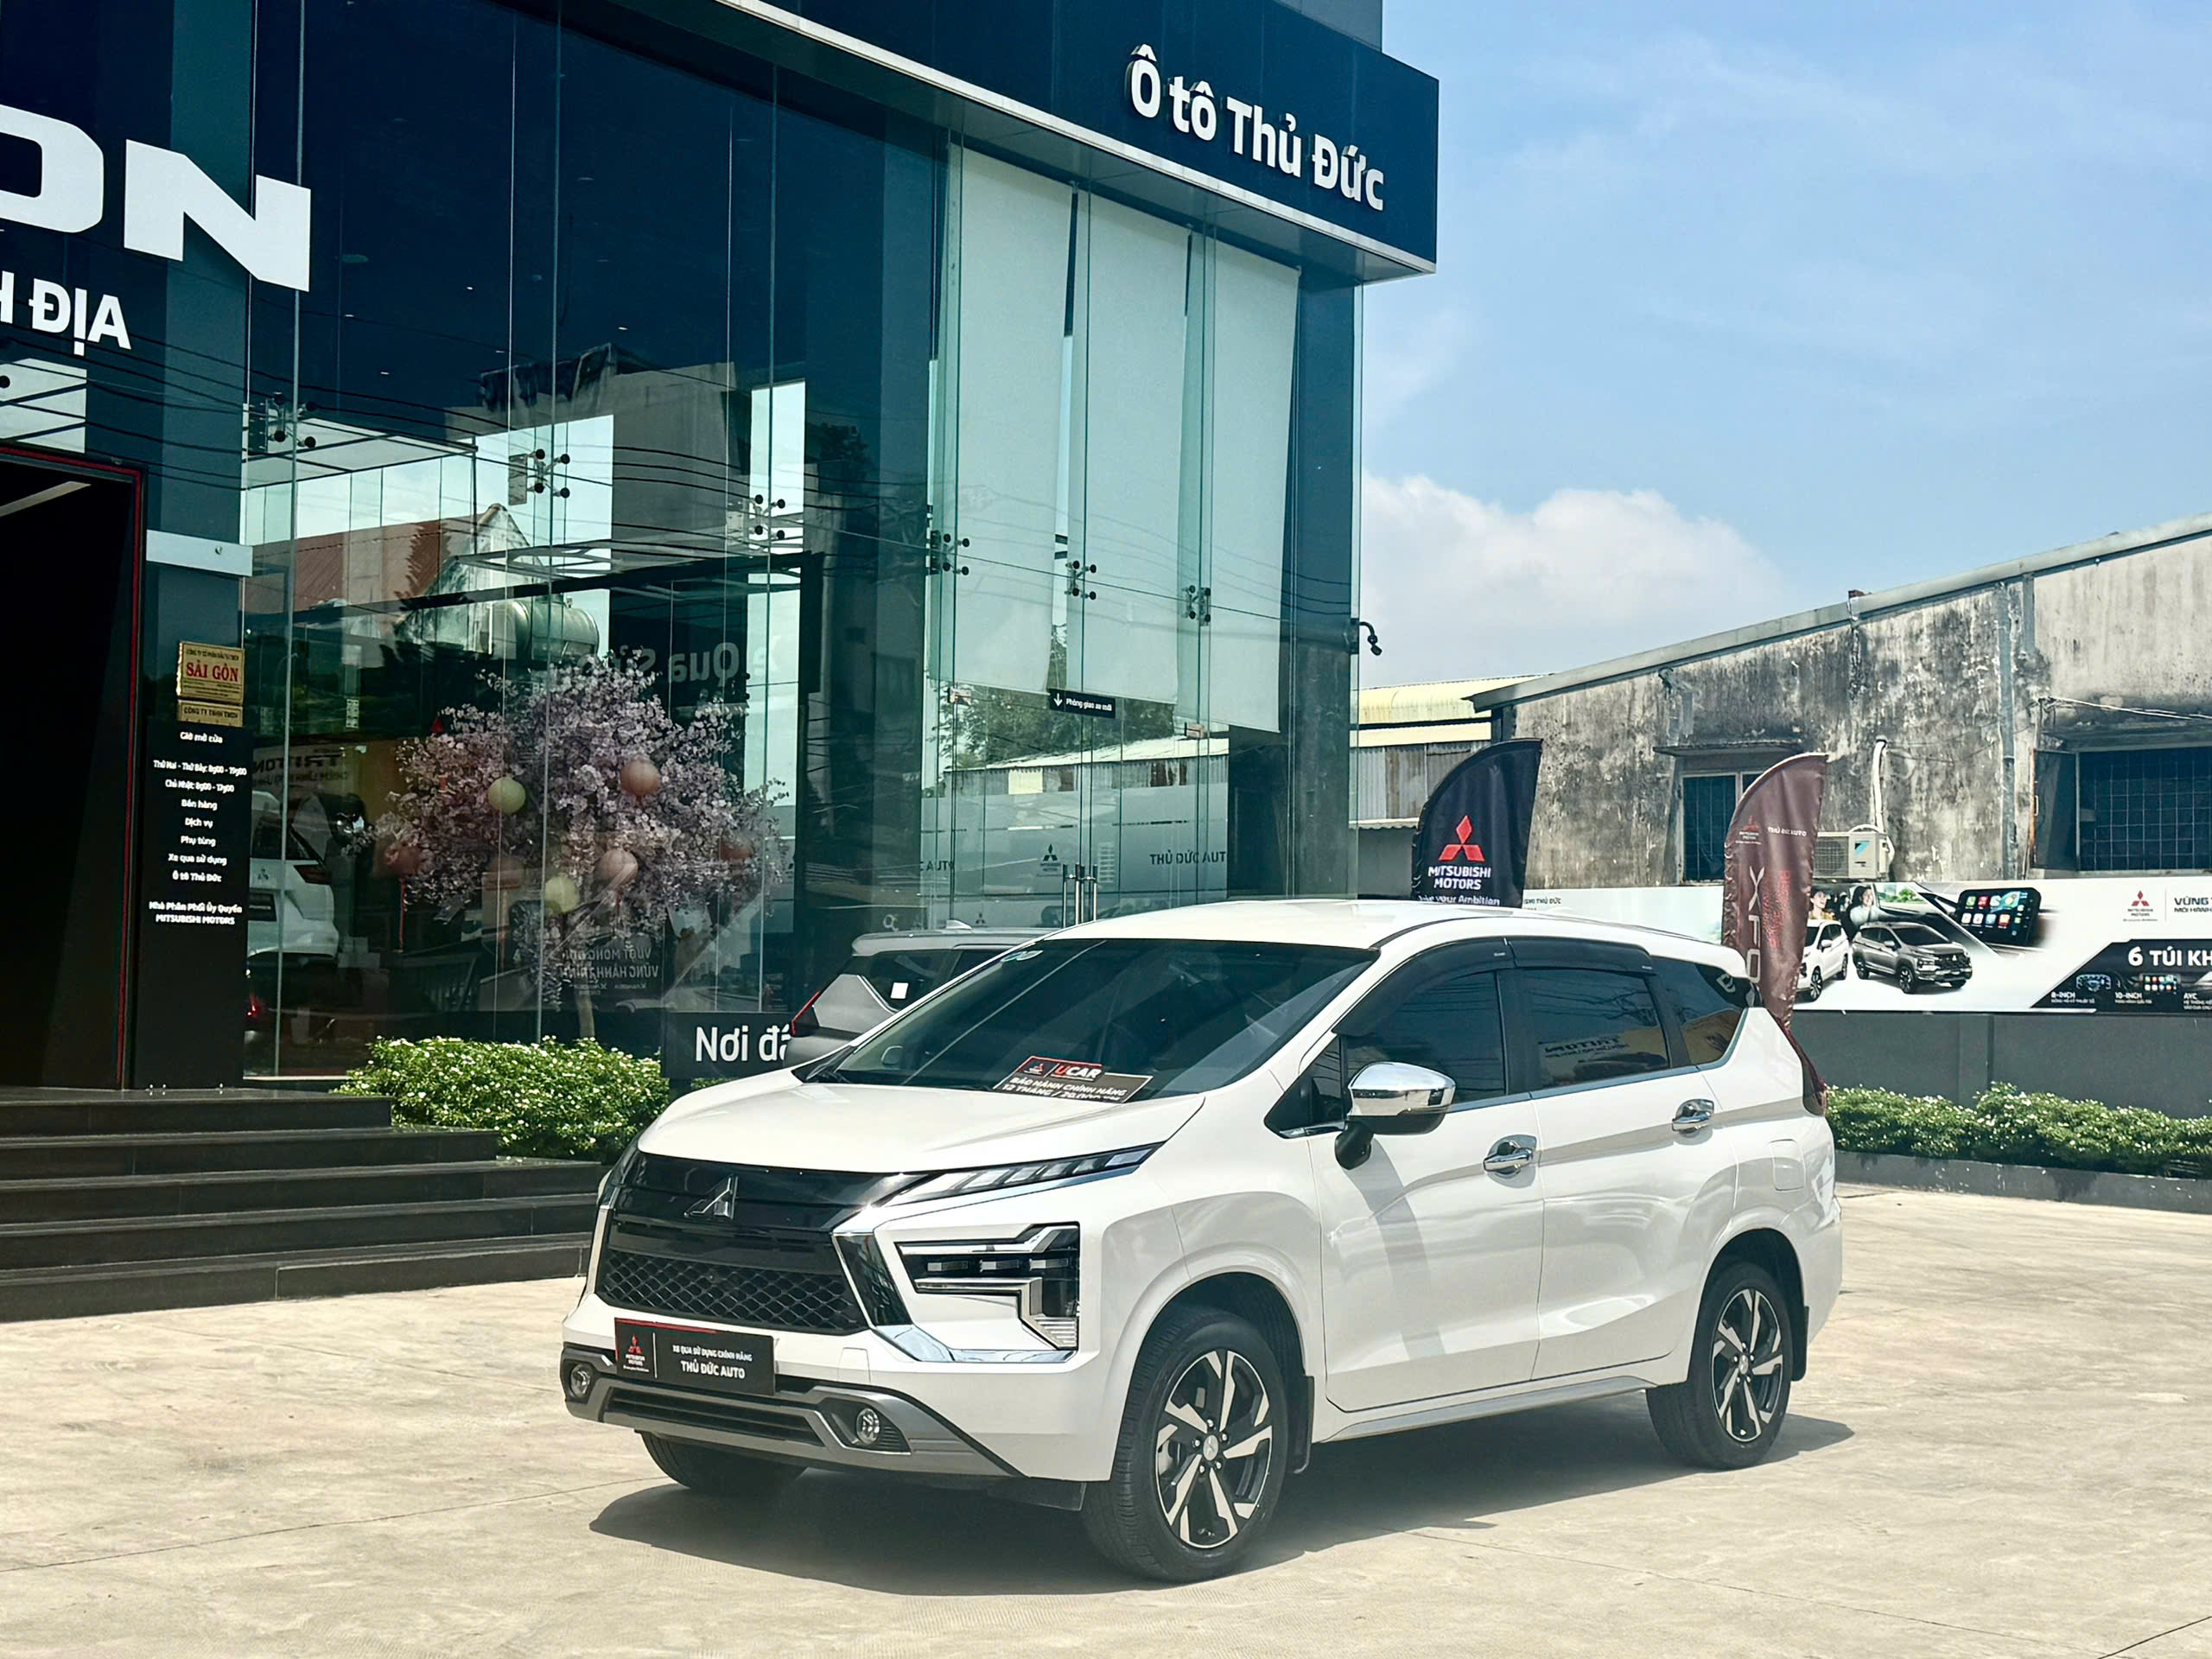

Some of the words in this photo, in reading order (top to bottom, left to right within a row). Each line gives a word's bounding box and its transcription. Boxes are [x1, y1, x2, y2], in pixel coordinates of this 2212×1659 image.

[1126, 43, 1161, 118] Ô
[1169, 76, 1217, 141] tô
[1226, 96, 1301, 178] Thủ
[1312, 135, 1384, 211] Đức
[29, 278, 131, 356] ĐỊA
[186, 659, 208, 678] SÀI
[212, 663, 238, 683] GÒN
[181, 798, 197, 808] Bán
[198, 799, 218, 811] hàng
[184, 817, 202, 828] Dịch
[203, 820, 213, 829] vụ
[181, 835, 197, 846] Phụ
[197, 836, 217, 848] tùng
[168, 853, 179, 861] Xe
[179, 855, 195, 863] qua
[207, 855, 227, 867] dụng
[1148, 848, 1173, 866] THỦ
[190, 872, 206, 881] Thủ
[206, 873, 222, 882] Đức
[1427, 865, 1491, 879] MITSUBISHI
[1433, 877, 1482, 891] MOTORS
[1458, 894, 1501, 906] Ambition
[156, 913, 201, 924] MITSUBISHI
[201, 915, 235, 925] MOTORS
[2127, 945, 2143, 967] 6
[2149, 945, 2183, 967] TÚI
[695, 1025, 749, 1062] Nơi
[1055, 1065, 1102, 1078] UCAR
[1008, 1075, 1034, 1085] BẢO
[1062, 1083, 1096, 1094] CHÍNH
[1015, 1084, 1054, 1097] THÁNG
[672, 1344, 681, 1354] XE
[680, 1345, 693, 1356] QUA
[701, 1348, 717, 1359] DỤNG
[717, 1349, 735, 1360] CHÍNH
[680, 1358, 700, 1374] THỦ
[700, 1360, 720, 1376] ĐỨC
[720, 1365, 746, 1380] AUTO
